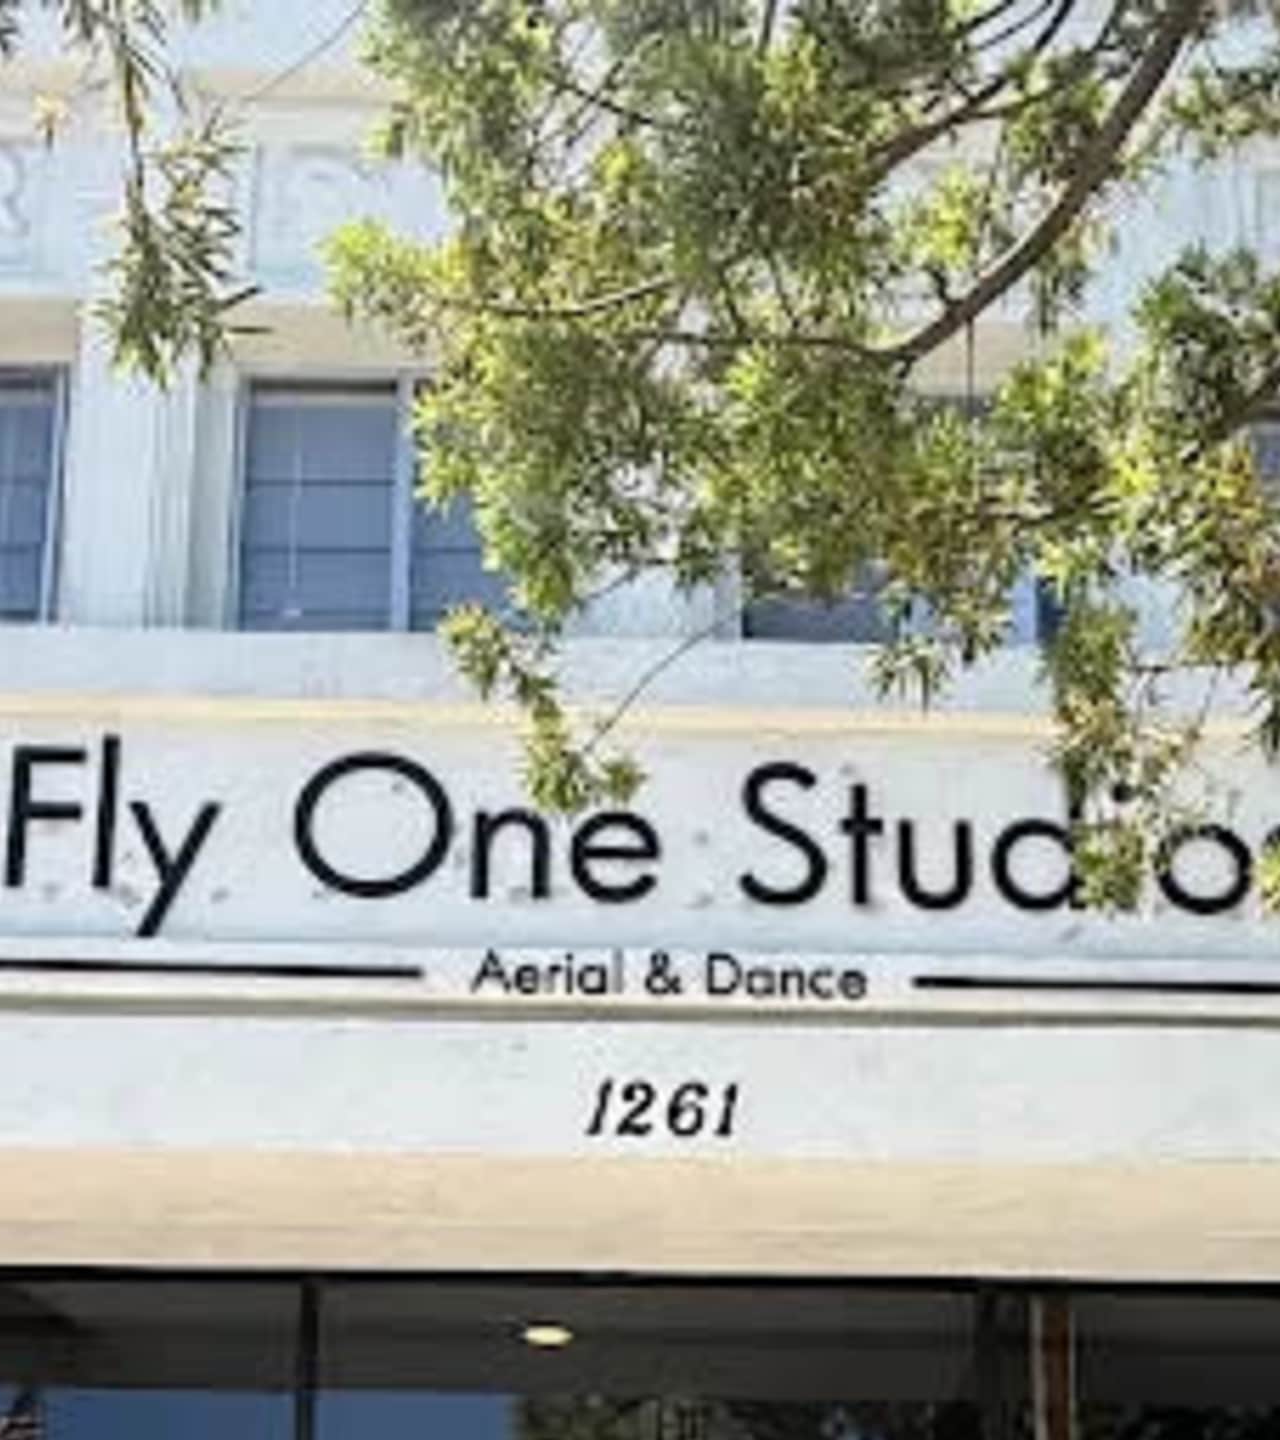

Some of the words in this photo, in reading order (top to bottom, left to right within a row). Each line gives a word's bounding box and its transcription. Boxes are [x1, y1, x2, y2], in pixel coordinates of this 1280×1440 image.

[4, 734, 222, 940] Fly
[293, 750, 662, 904] One
[471, 947, 624, 995] Aerial
[643, 951, 683, 995] &
[705, 951, 869, 1000] Dance
[586, 1078, 739, 1137] 1261
